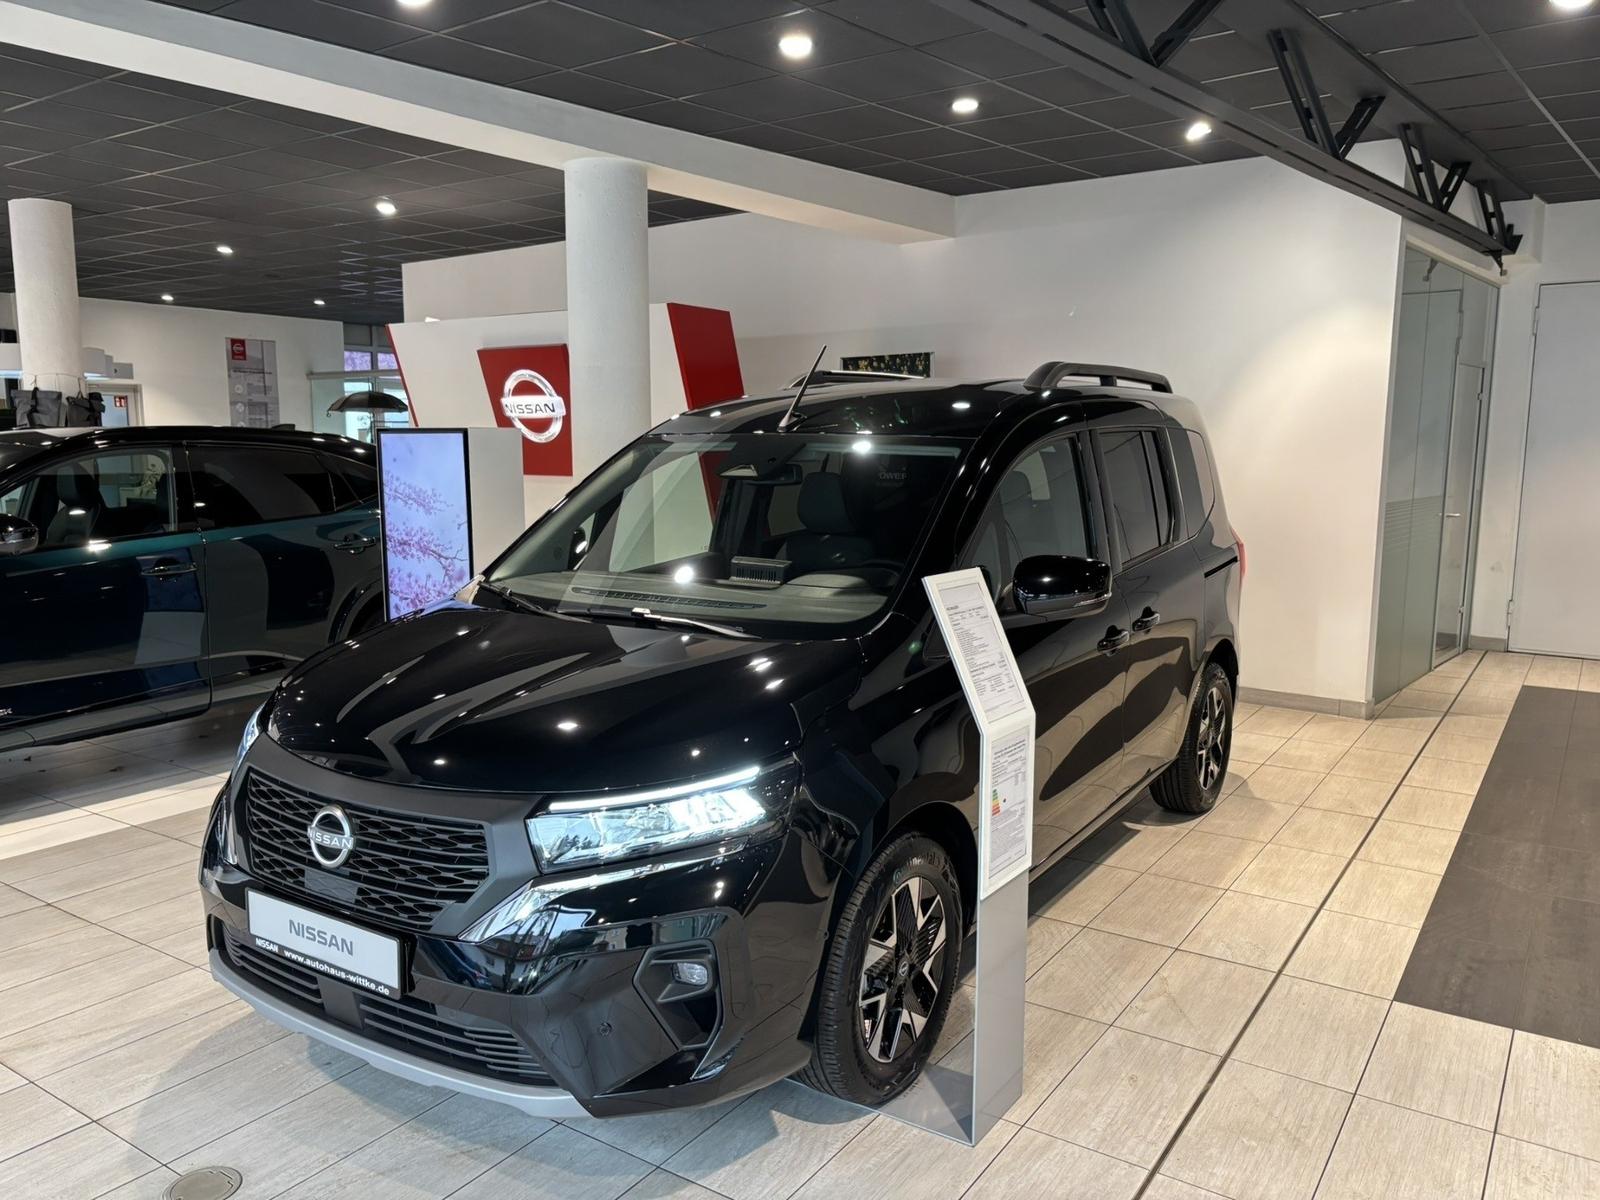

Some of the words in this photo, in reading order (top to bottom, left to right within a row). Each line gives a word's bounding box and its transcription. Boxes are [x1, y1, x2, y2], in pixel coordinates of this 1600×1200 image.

[504, 402, 556, 414] NISSAN
[307, 825, 353, 849] NISSAN
[289, 920, 353, 956] NISSAN
[255, 938, 279, 953] NISSAN
[284, 950, 390, 996] www.autohaus-wittke.de
